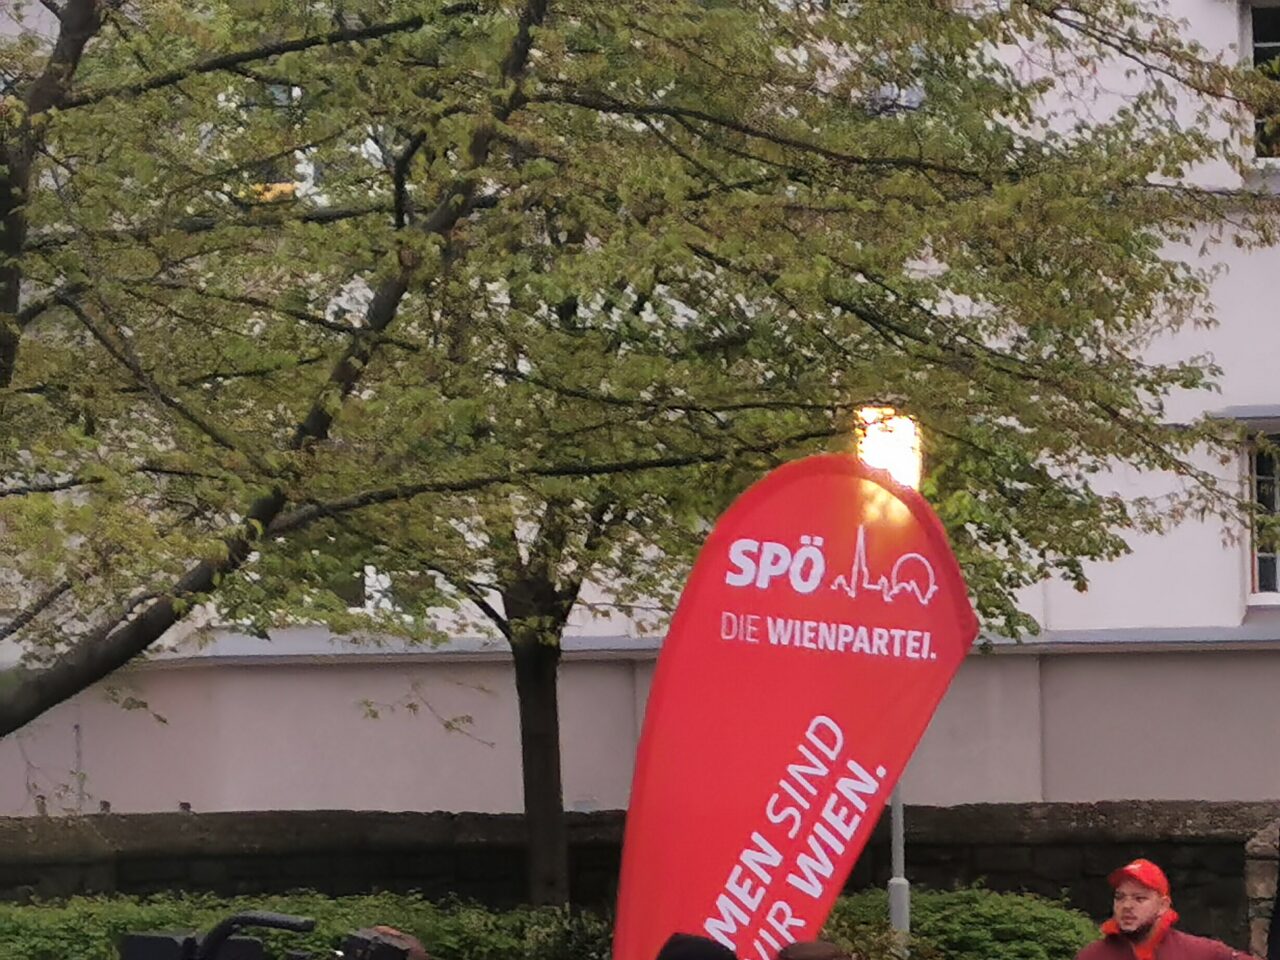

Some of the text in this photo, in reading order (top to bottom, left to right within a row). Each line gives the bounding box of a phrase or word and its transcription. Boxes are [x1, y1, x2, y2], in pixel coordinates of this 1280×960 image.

[726, 535, 825, 594] SPÖ
[721, 612, 937, 660] DIE WIENPARTEI.
[766, 715, 844, 838] SIND
[787, 760, 887, 899] WIEN.
